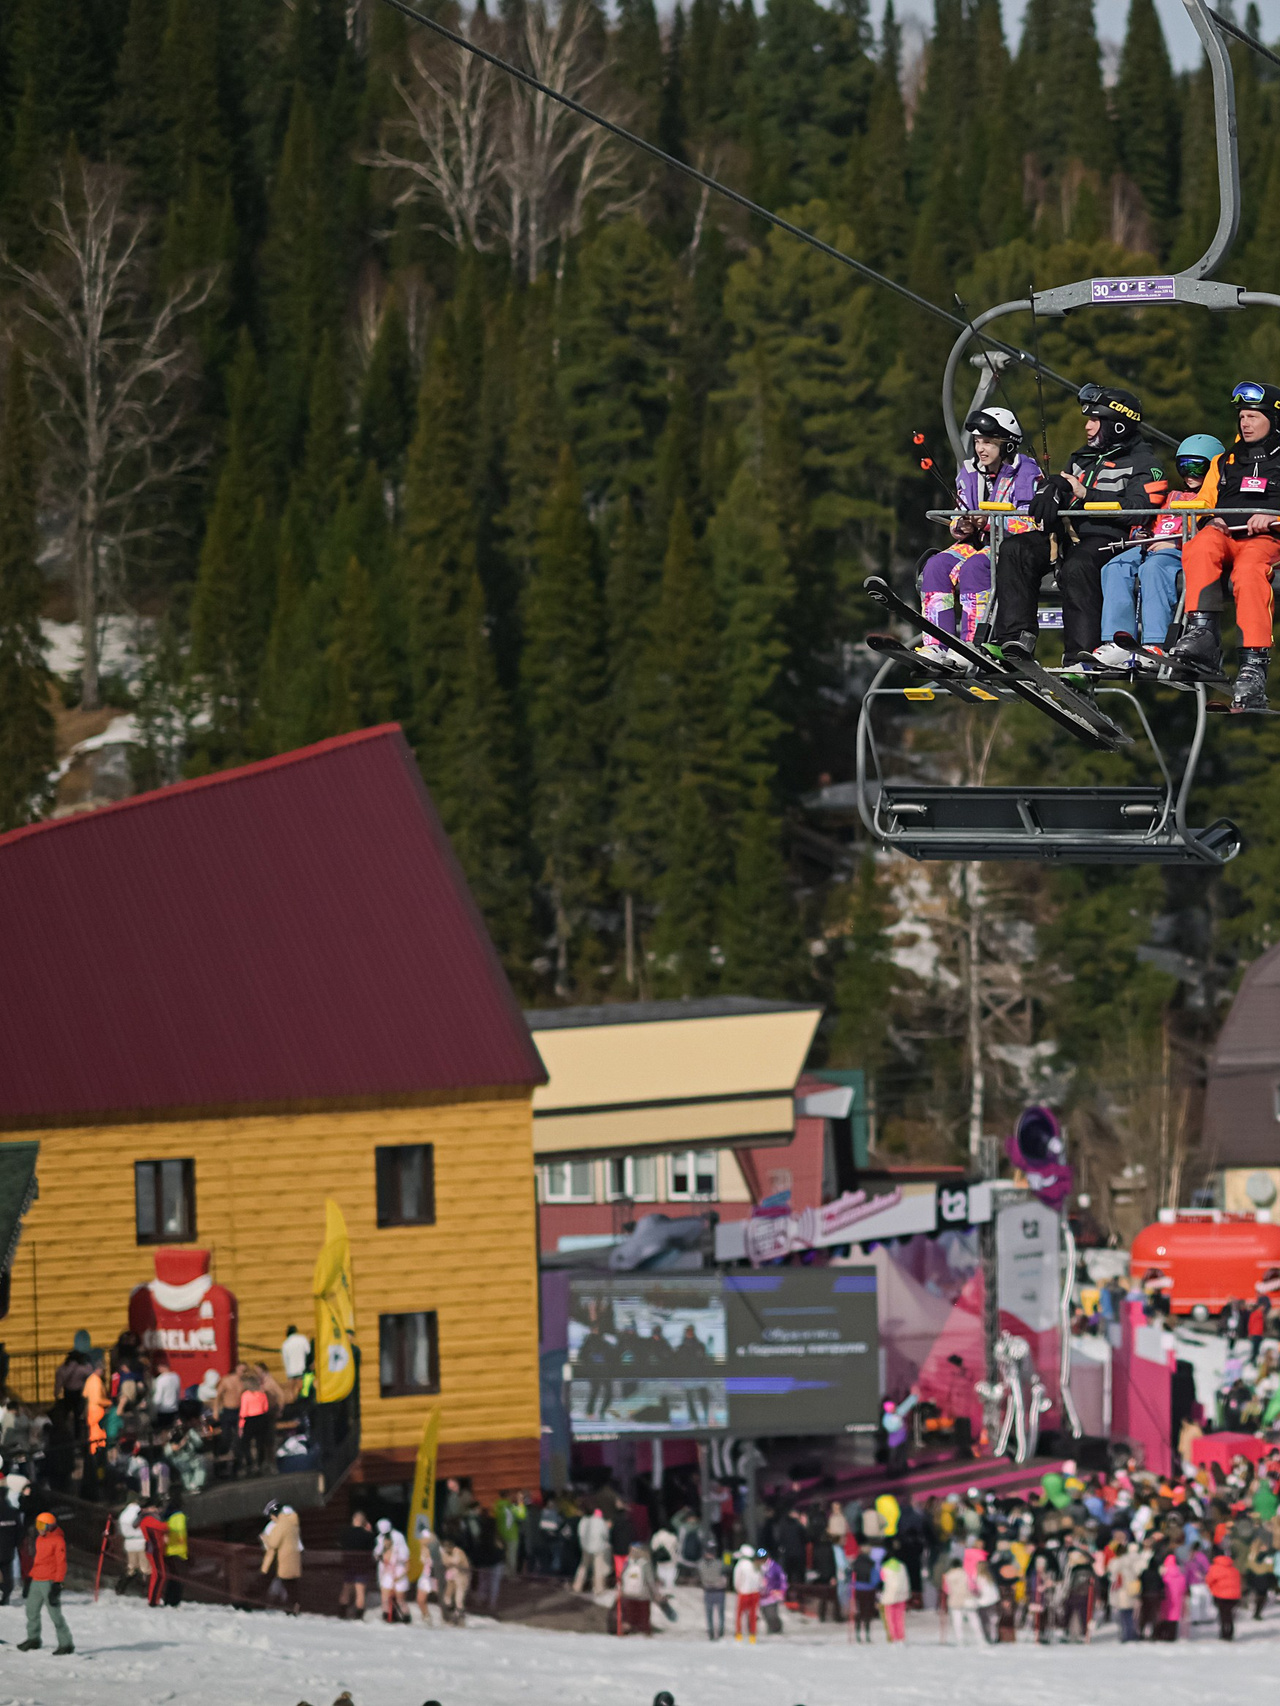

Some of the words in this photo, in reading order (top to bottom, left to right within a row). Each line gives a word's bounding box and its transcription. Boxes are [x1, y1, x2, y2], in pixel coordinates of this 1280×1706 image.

[1094, 284, 1109, 296] 30
[1138, 281, 1146, 292] E
[1043, 613, 1050, 621] E
[942, 1189, 967, 1220] t2
